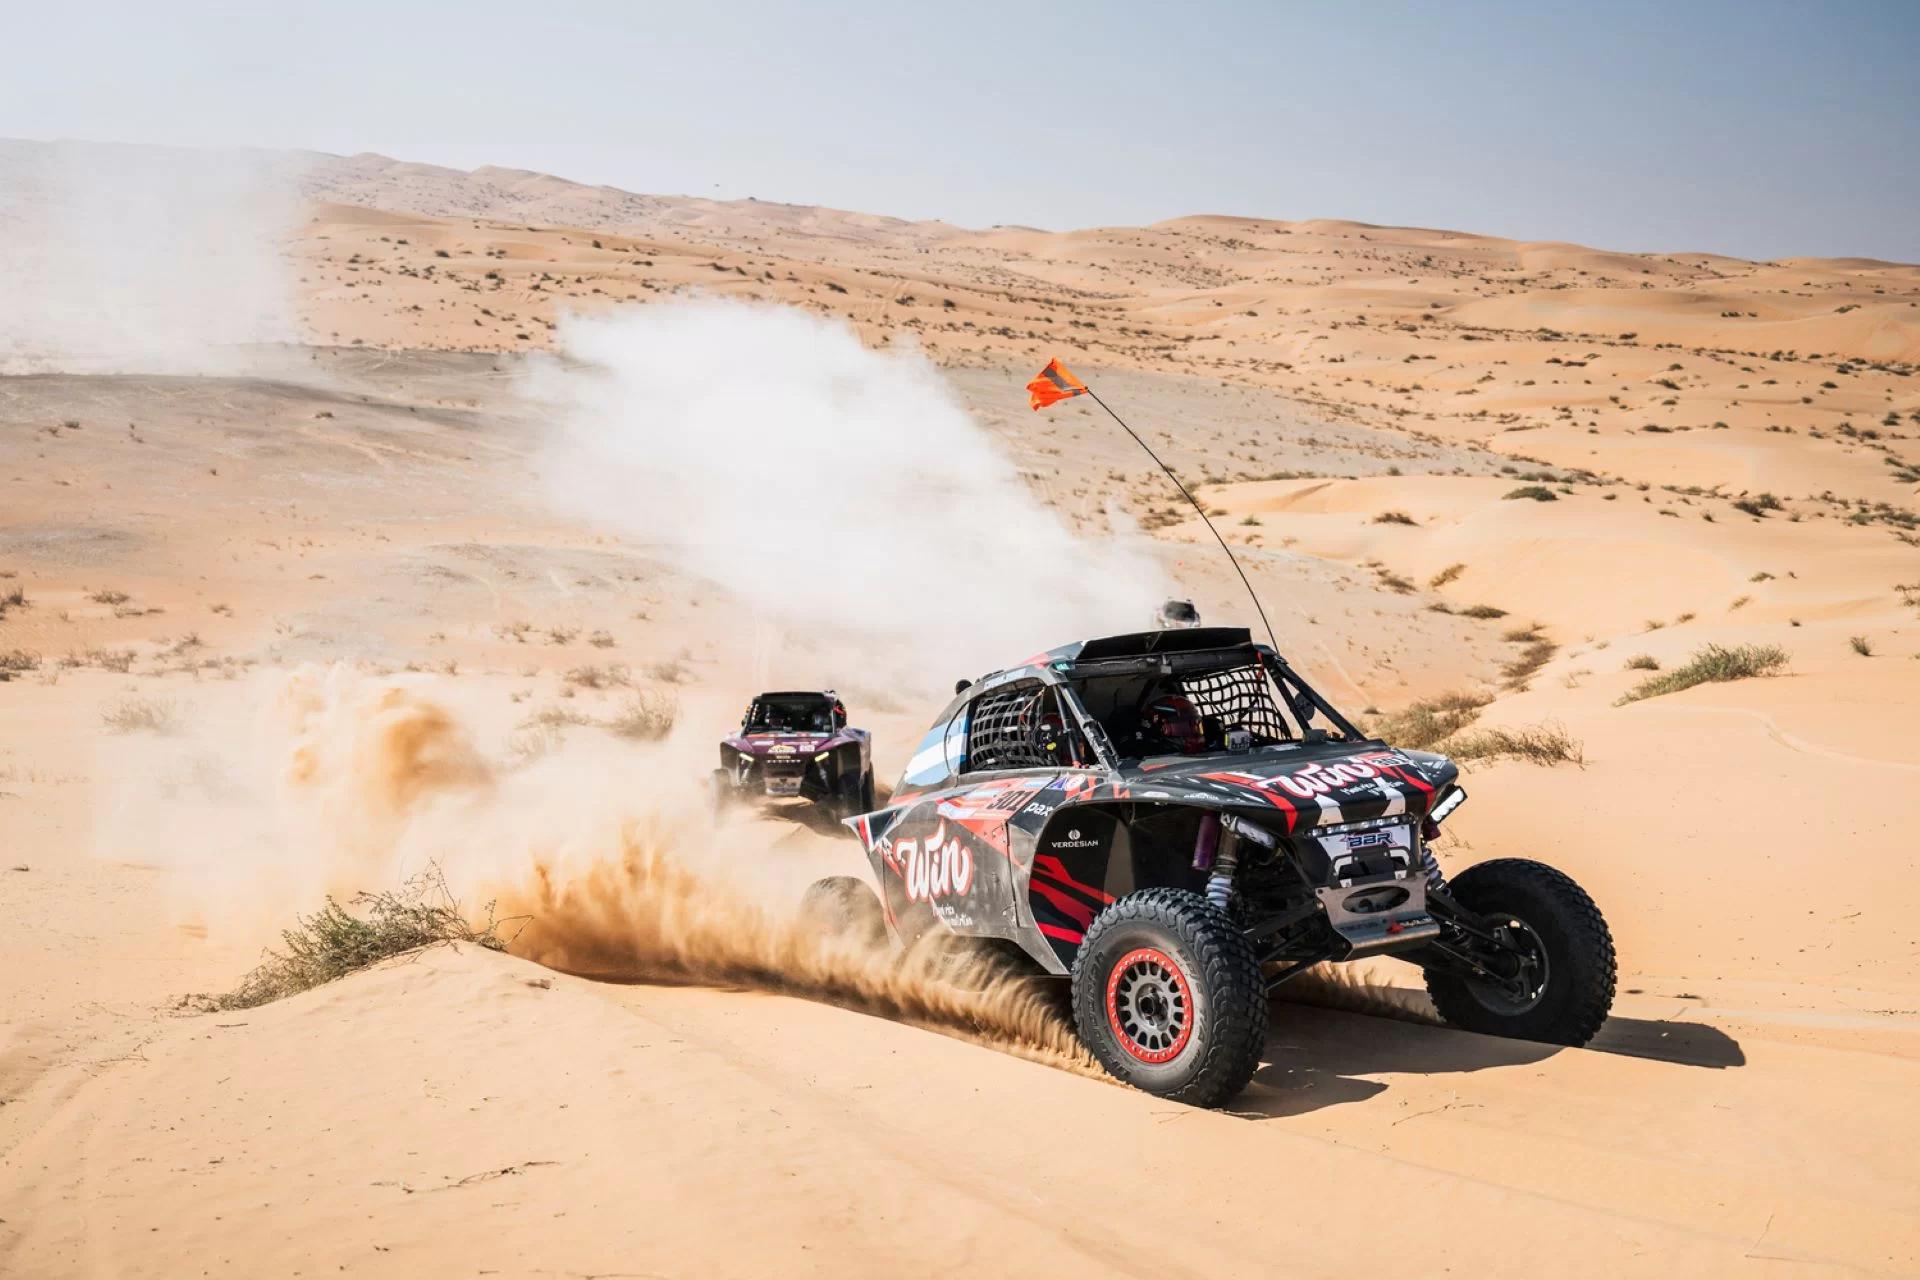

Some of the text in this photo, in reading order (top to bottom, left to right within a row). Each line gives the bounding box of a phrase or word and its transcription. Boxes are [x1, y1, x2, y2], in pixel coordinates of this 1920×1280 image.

[1254, 762, 1379, 799] Win
[986, 790, 1034, 811] 301
[1051, 840, 1099, 848] VERDESIAN
[1347, 831, 1394, 848] BBR
[895, 820, 972, 902] Win
